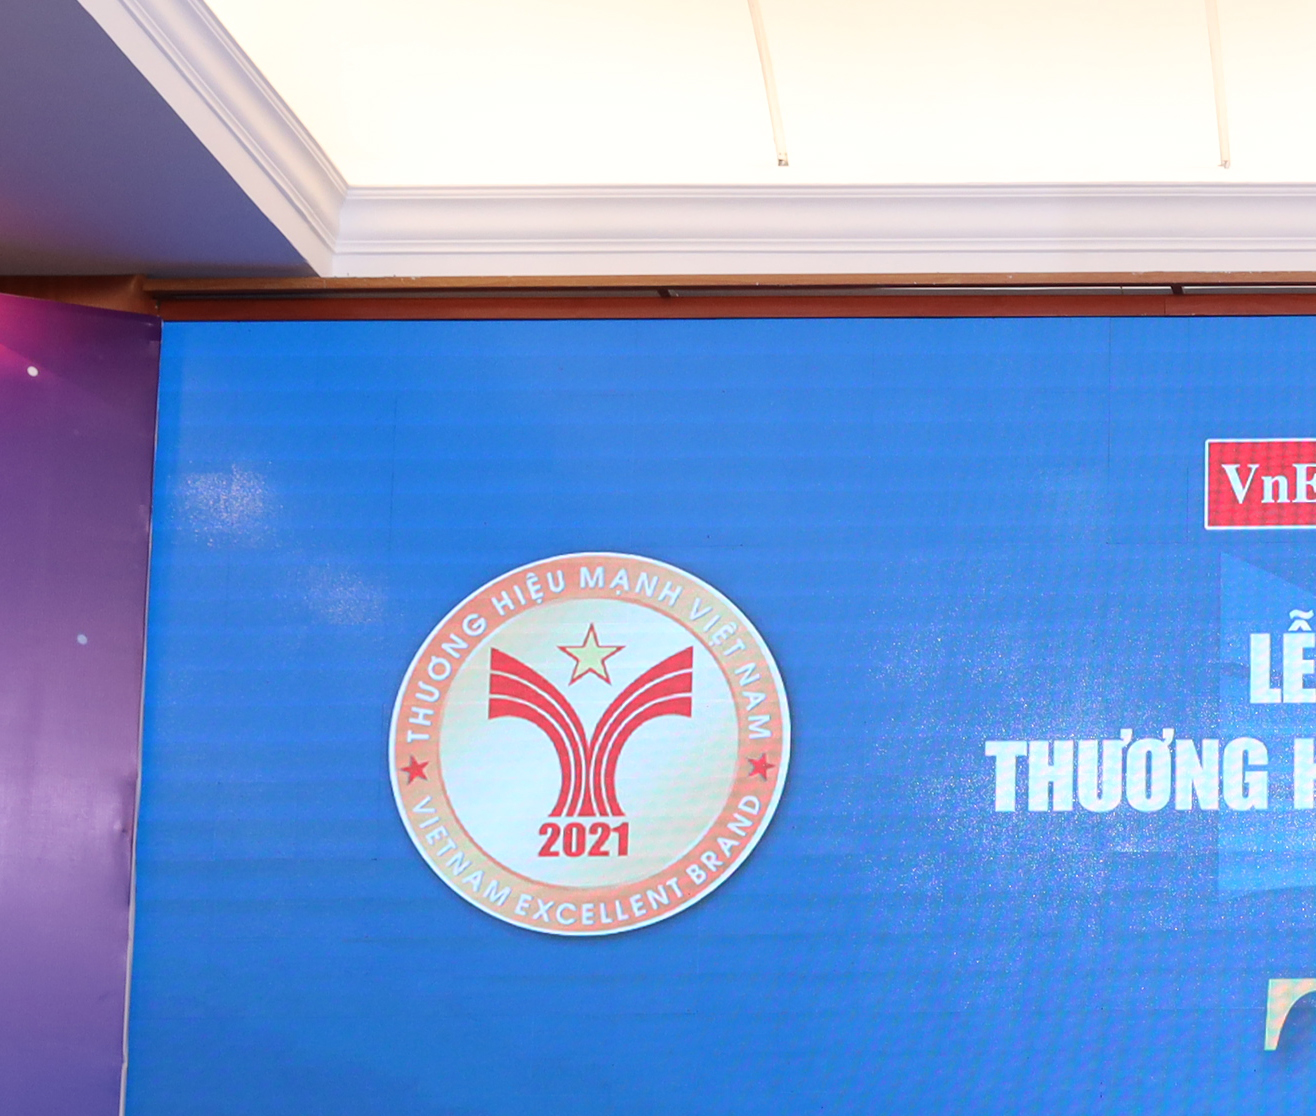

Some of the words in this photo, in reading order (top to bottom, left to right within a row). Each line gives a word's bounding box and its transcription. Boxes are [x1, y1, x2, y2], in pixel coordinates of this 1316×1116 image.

[407, 613, 487, 743] THƯƠNG
[491, 571, 566, 617] HIỆU
[580, 566, 683, 607] MẠNH
[689, 597, 746, 657] VIỆT
[734, 662, 772, 740] NAM
[1249, 608, 1316, 704] LỄ
[985, 728, 1269, 813] THƯƠNG
[412, 795, 512, 906] VIETNAM
[514, 877, 683, 926] EXCELLENT
[685, 795, 761, 885] BRAND
[538, 822, 629, 857] 2021
